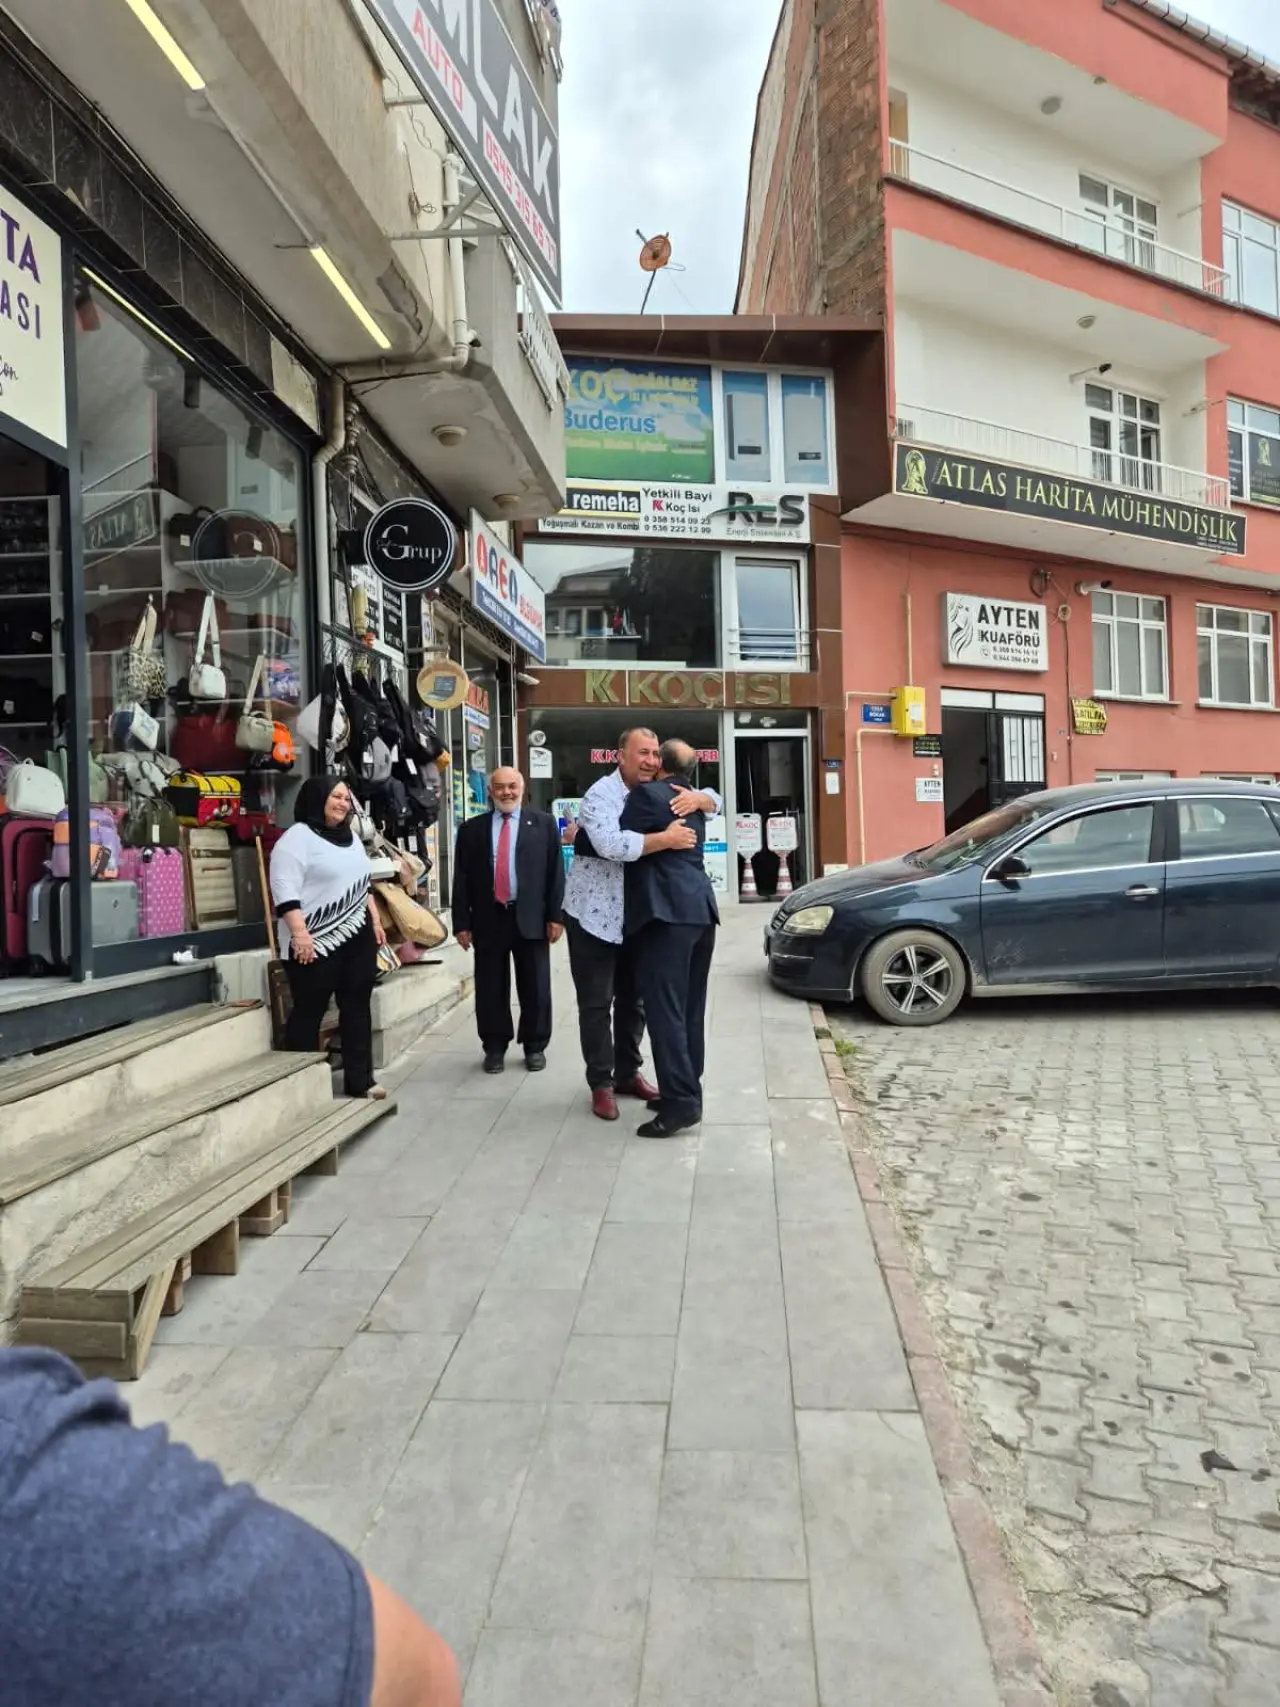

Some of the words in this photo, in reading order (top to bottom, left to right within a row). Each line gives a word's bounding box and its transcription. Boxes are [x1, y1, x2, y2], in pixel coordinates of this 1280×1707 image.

[411, 8, 463, 111] AUTO
[564, 408, 656, 433] Buderus
[572, 491, 639, 512] remeha
[642, 487, 681, 500] Yetkili
[685, 490, 713, 503] Bayi
[935, 461, 1006, 498] ATLAS
[1015, 478, 1096, 515] HARİTA
[1102, 494, 1238, 542] MÜHENDİSLİK
[665, 503, 686, 515] Koç
[728, 491, 805, 525] RES
[581, 520, 604, 529] Kazan
[617, 521, 640, 530] Kombi
[381, 524, 443, 564] Grup
[977, 604, 1040, 630] AYTEN
[980, 629, 1040, 648] KUAFÖRÜ
[629, 672, 724, 708] KOÇ
